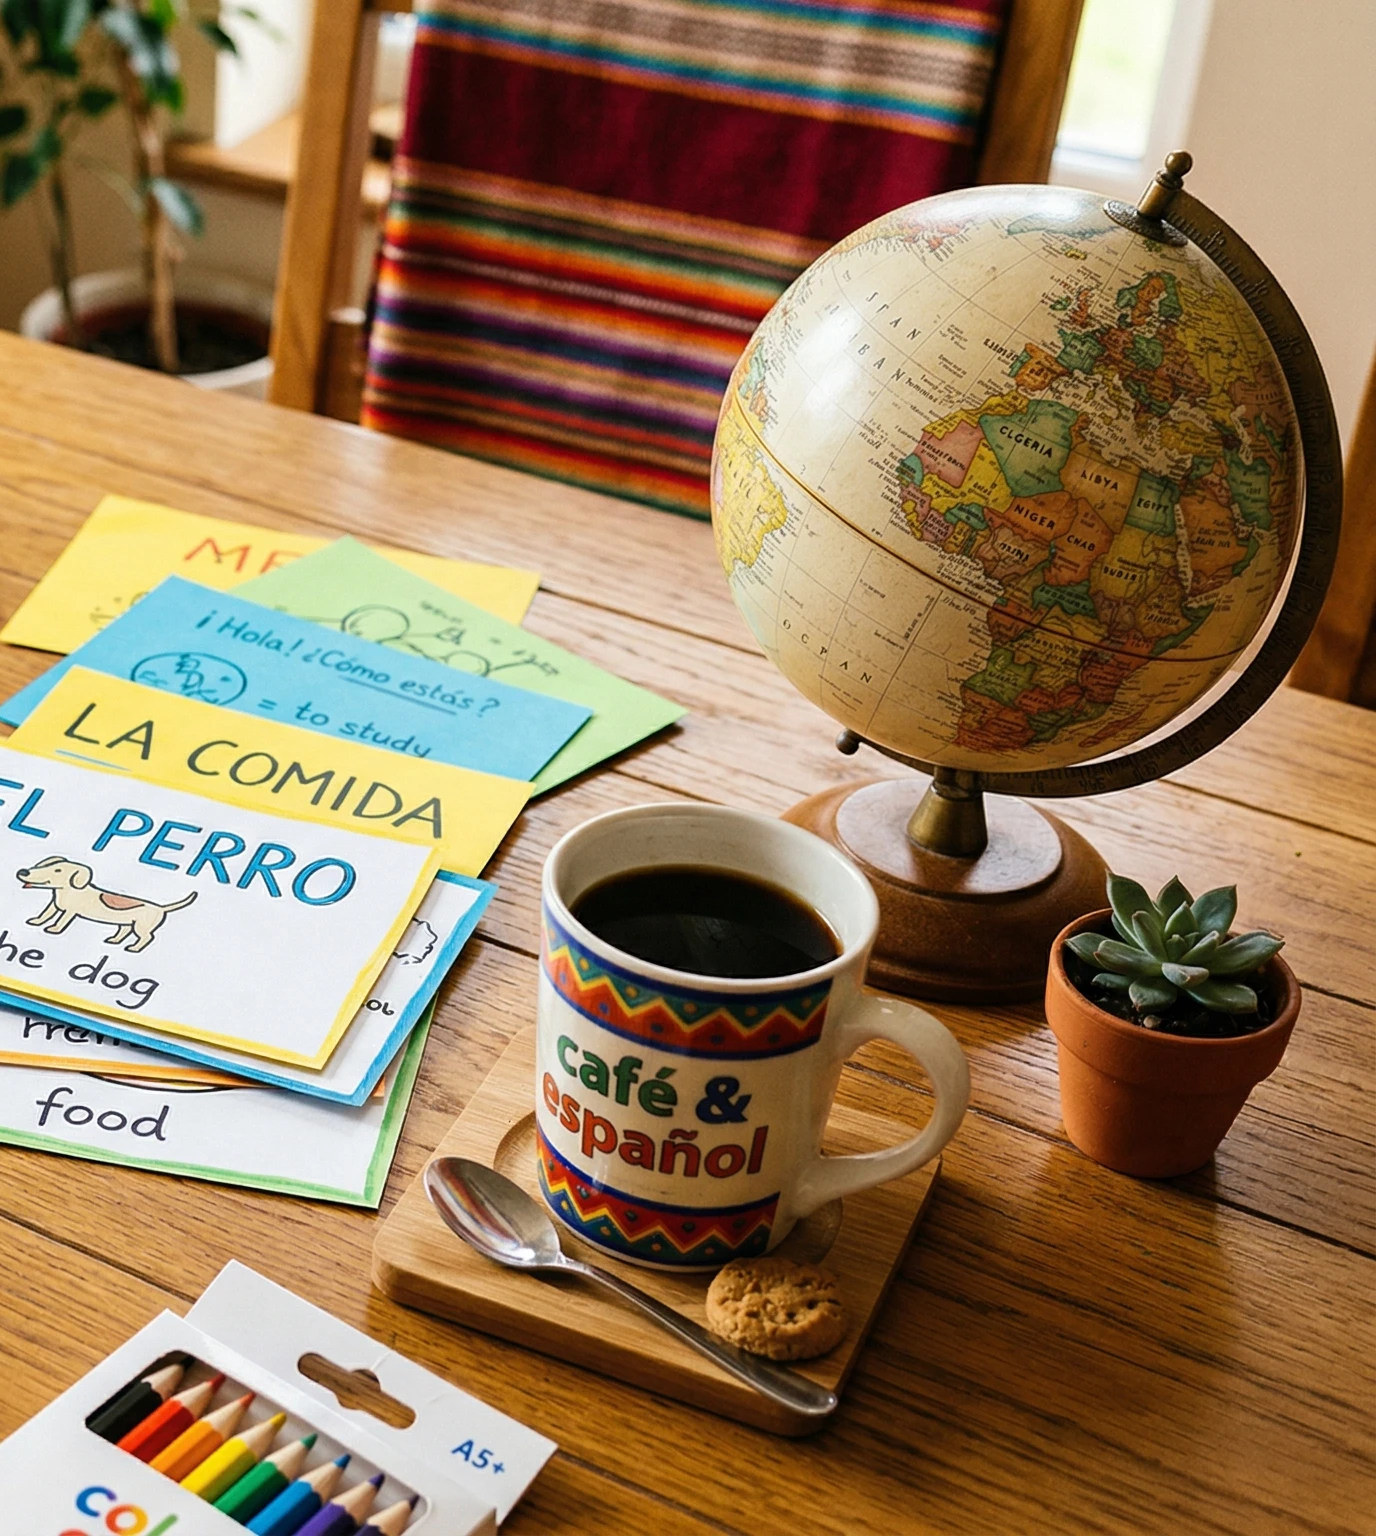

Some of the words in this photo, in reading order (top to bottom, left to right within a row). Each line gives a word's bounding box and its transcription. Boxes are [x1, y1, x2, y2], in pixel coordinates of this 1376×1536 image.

[1013, 504, 1056, 530] NIGER
[294, 701, 329, 726] to
[339, 721, 431, 759] study
[63, 701, 153, 760] LA
[186, 738, 443, 840] COMIDA
[91, 807, 357, 906] PERRO
[68, 955, 162, 1010] dog
[556, 1033, 679, 1117] café
[695, 1075, 753, 1125] &
[35, 1086, 170, 1141] food
[542, 1070, 769, 1179] español
[451, 1438, 506, 1477] A5+
